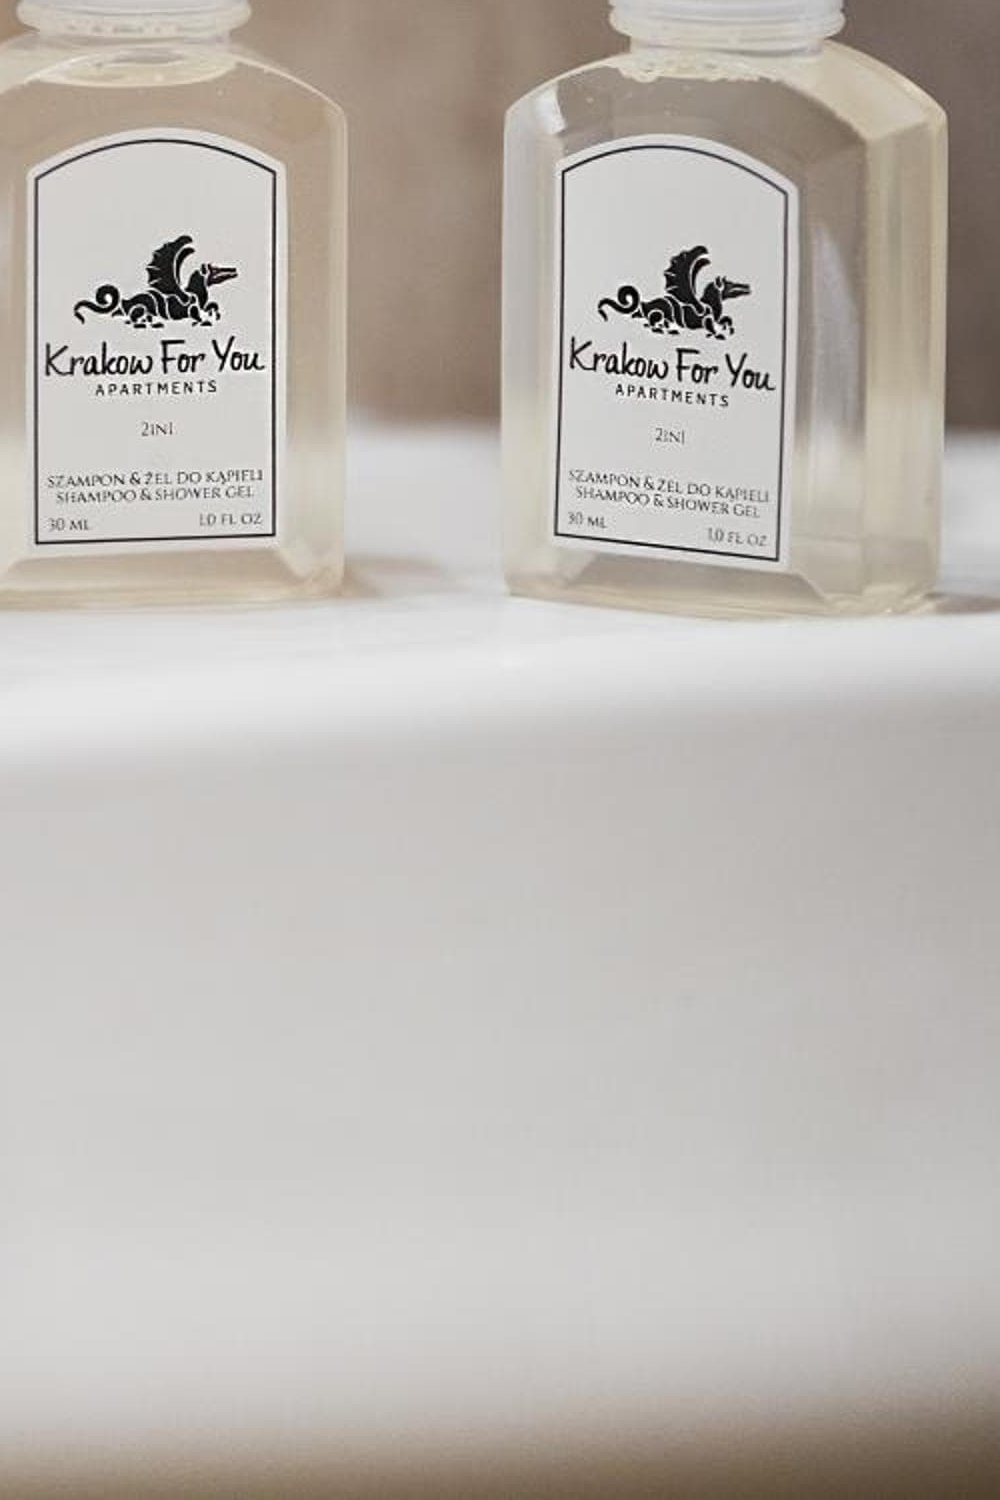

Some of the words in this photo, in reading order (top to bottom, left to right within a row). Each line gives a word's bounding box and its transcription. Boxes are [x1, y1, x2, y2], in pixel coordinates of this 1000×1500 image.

[45, 340, 153, 377] Krakow
[161, 340, 205, 375] For
[212, 335, 265, 373] You
[569, 336, 668, 380] Krakow
[675, 347, 719, 384] For
[725, 352, 776, 391] You
[95, 380, 217, 397] APARTMENTS
[615, 383, 729, 408] APARTMENTS
[47, 474, 126, 489] SZAMPON
[129, 471, 141, 485] &
[177, 471, 202, 485] DO
[568, 469, 640, 488] SZAMPON
[643, 475, 655, 491] &
[687, 483, 712, 497] DO
[56, 489, 137, 504] SHAMPOO
[140, 487, 152, 501] &
[155, 487, 222, 501] SHOWER
[225, 485, 255, 499] GEL
[576, 485, 651, 506] SHAMPOO
[653, 493, 664, 508] &
[666, 496, 729, 515] SHOWER
[732, 503, 760, 519] GEL
[48, 517, 65, 532] 30
[241, 513, 263, 525] OZ
[568, 511, 583, 525] 30
[587, 515, 607, 529] ML
[746, 533, 767, 547] OZ
